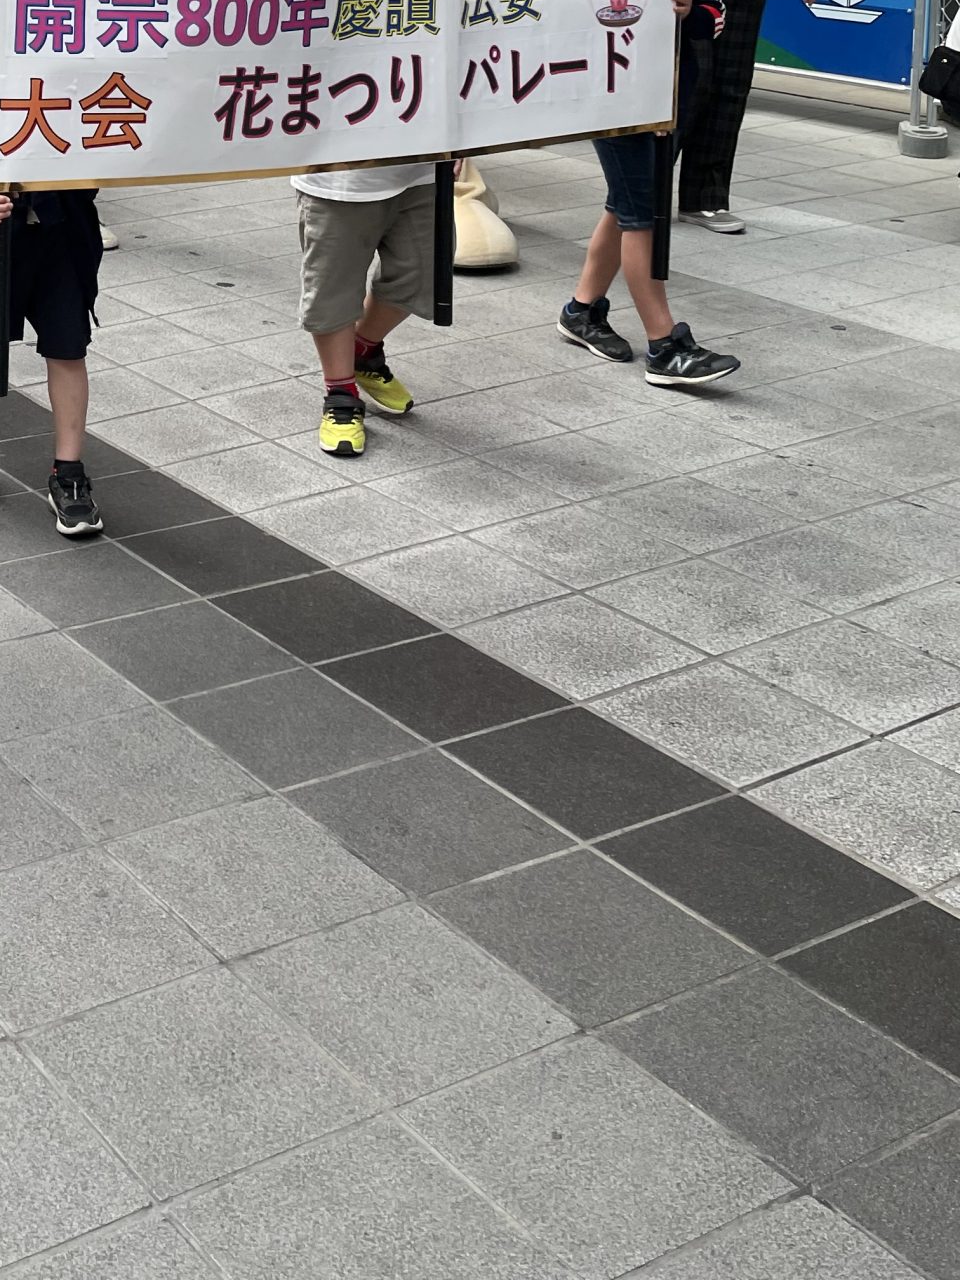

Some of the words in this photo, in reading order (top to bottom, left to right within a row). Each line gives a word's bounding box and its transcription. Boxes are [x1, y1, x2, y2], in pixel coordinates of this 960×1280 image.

[214, 53, 423, 142] 花まつり
[459, 29, 636, 105] パレード
